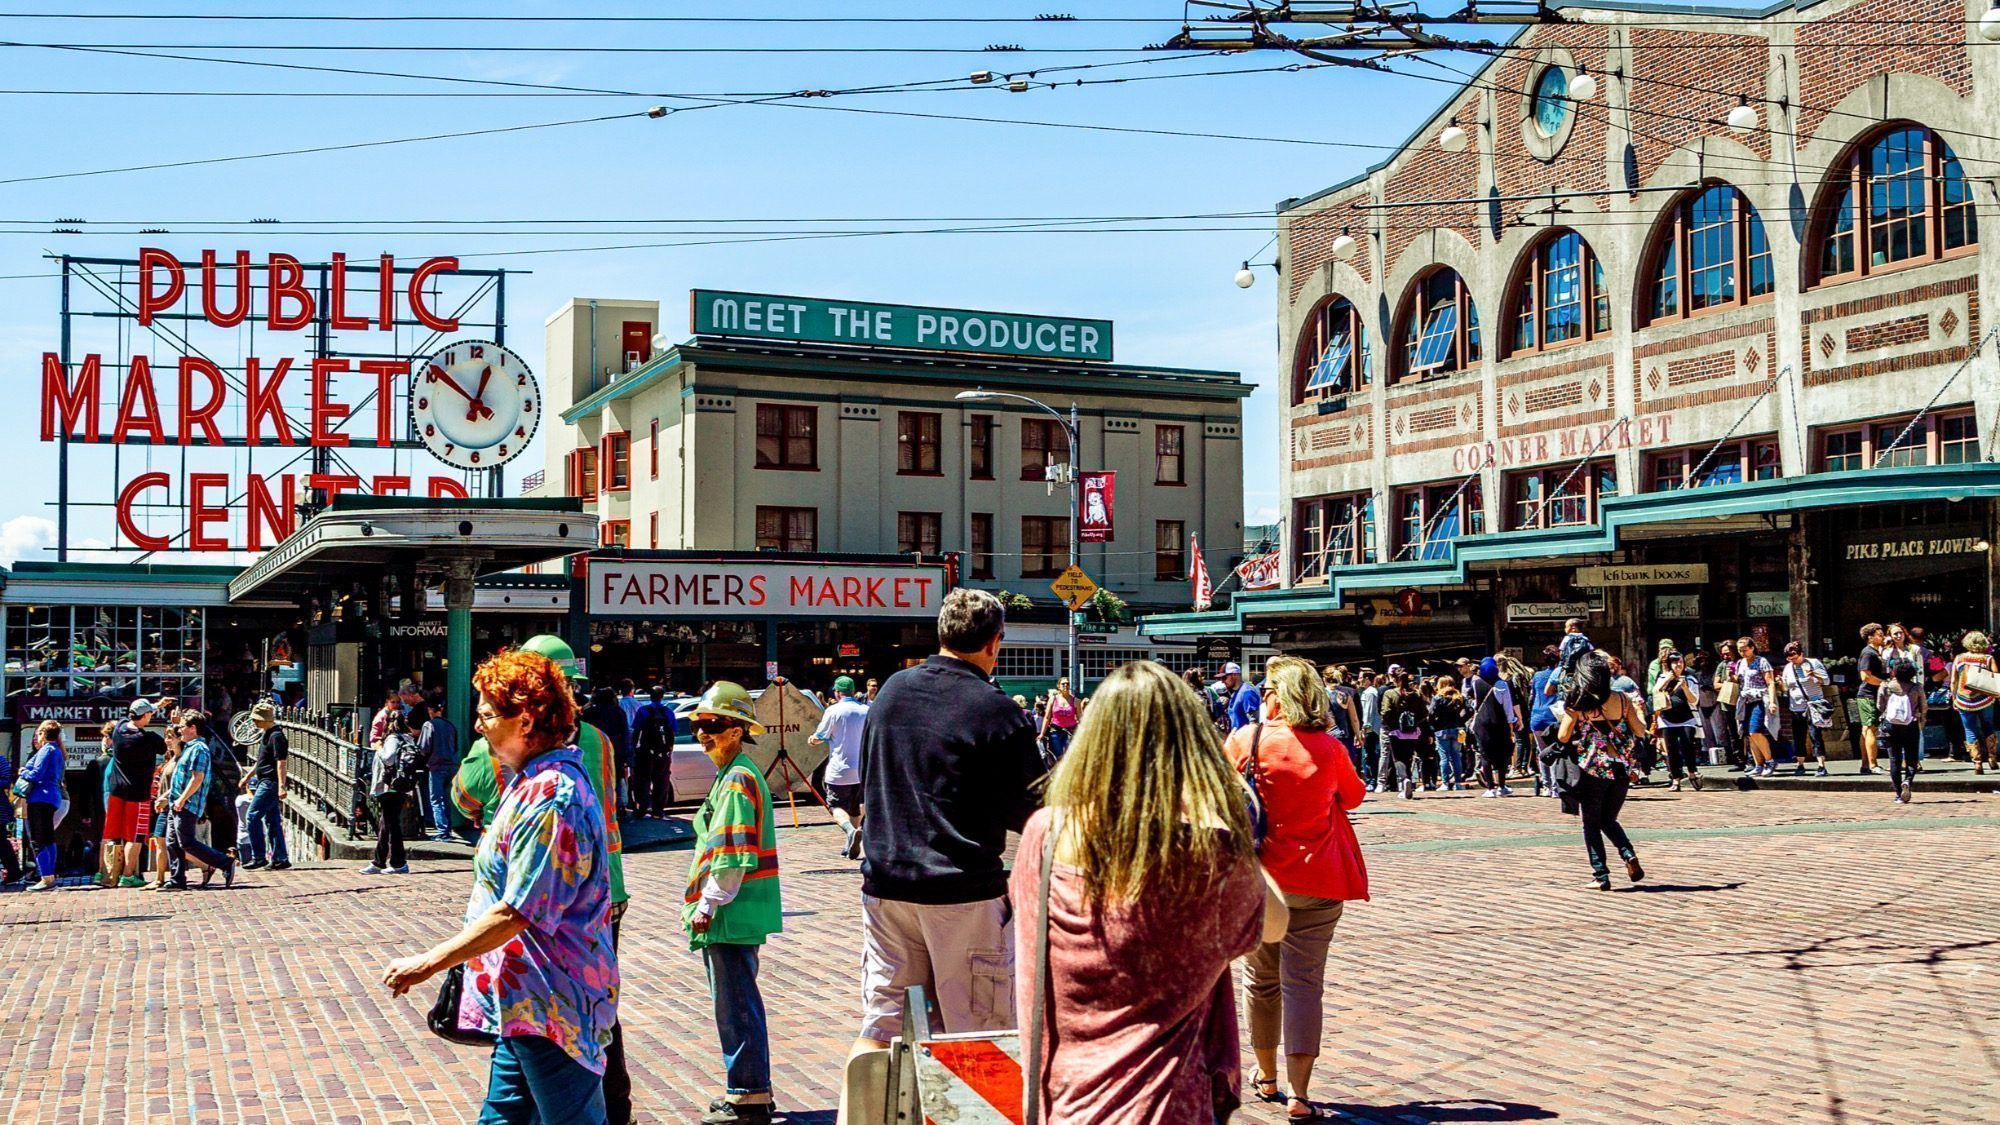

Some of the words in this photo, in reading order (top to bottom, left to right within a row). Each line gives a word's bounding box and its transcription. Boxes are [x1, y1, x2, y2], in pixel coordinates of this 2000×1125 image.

[138, 247, 459, 332] PUBLIC
[712, 298, 807, 334] MEET
[828, 307, 892, 340] THE
[918, 314, 1099, 354] PRODUCER
[445, 352, 455, 365] 11
[470, 346, 483, 358] 12
[500, 354, 505, 366] 1
[426, 371, 438, 383] 10
[518, 374, 526, 385] 2
[41, 352, 411, 447] MARKET
[419, 397, 428, 410] 9
[524, 400, 532, 412] 3
[426, 424, 434, 437] 8
[515, 426, 525, 438] 4
[445, 444, 454, 455] 7
[498, 444, 507, 456] 5
[1453, 434, 1549, 473] CORNER
[1560, 415, 1672, 457] MARKET
[471, 452, 480, 463] 6
[116, 471, 469, 552] CEN
[1846, 543, 1878, 560] PIKE
[1881, 540, 1924, 558] PLACE
[1621, 570, 1650, 581] bank
[1654, 569, 1690, 580] books
[603, 573, 766, 606] FARMERS
[790, 575, 932, 608] MARKET
[1512, 605, 1527, 615] The
[1529, 604, 1562, 616] Crumpet
[1564, 604, 1585, 616] Shop
[1656, 602, 1677, 618] left
[1749, 599, 1784, 616] books
[1081, 624, 1097, 632] Pike
[31, 706, 93, 719] MARKET
[100, 706, 166, 719] THER
